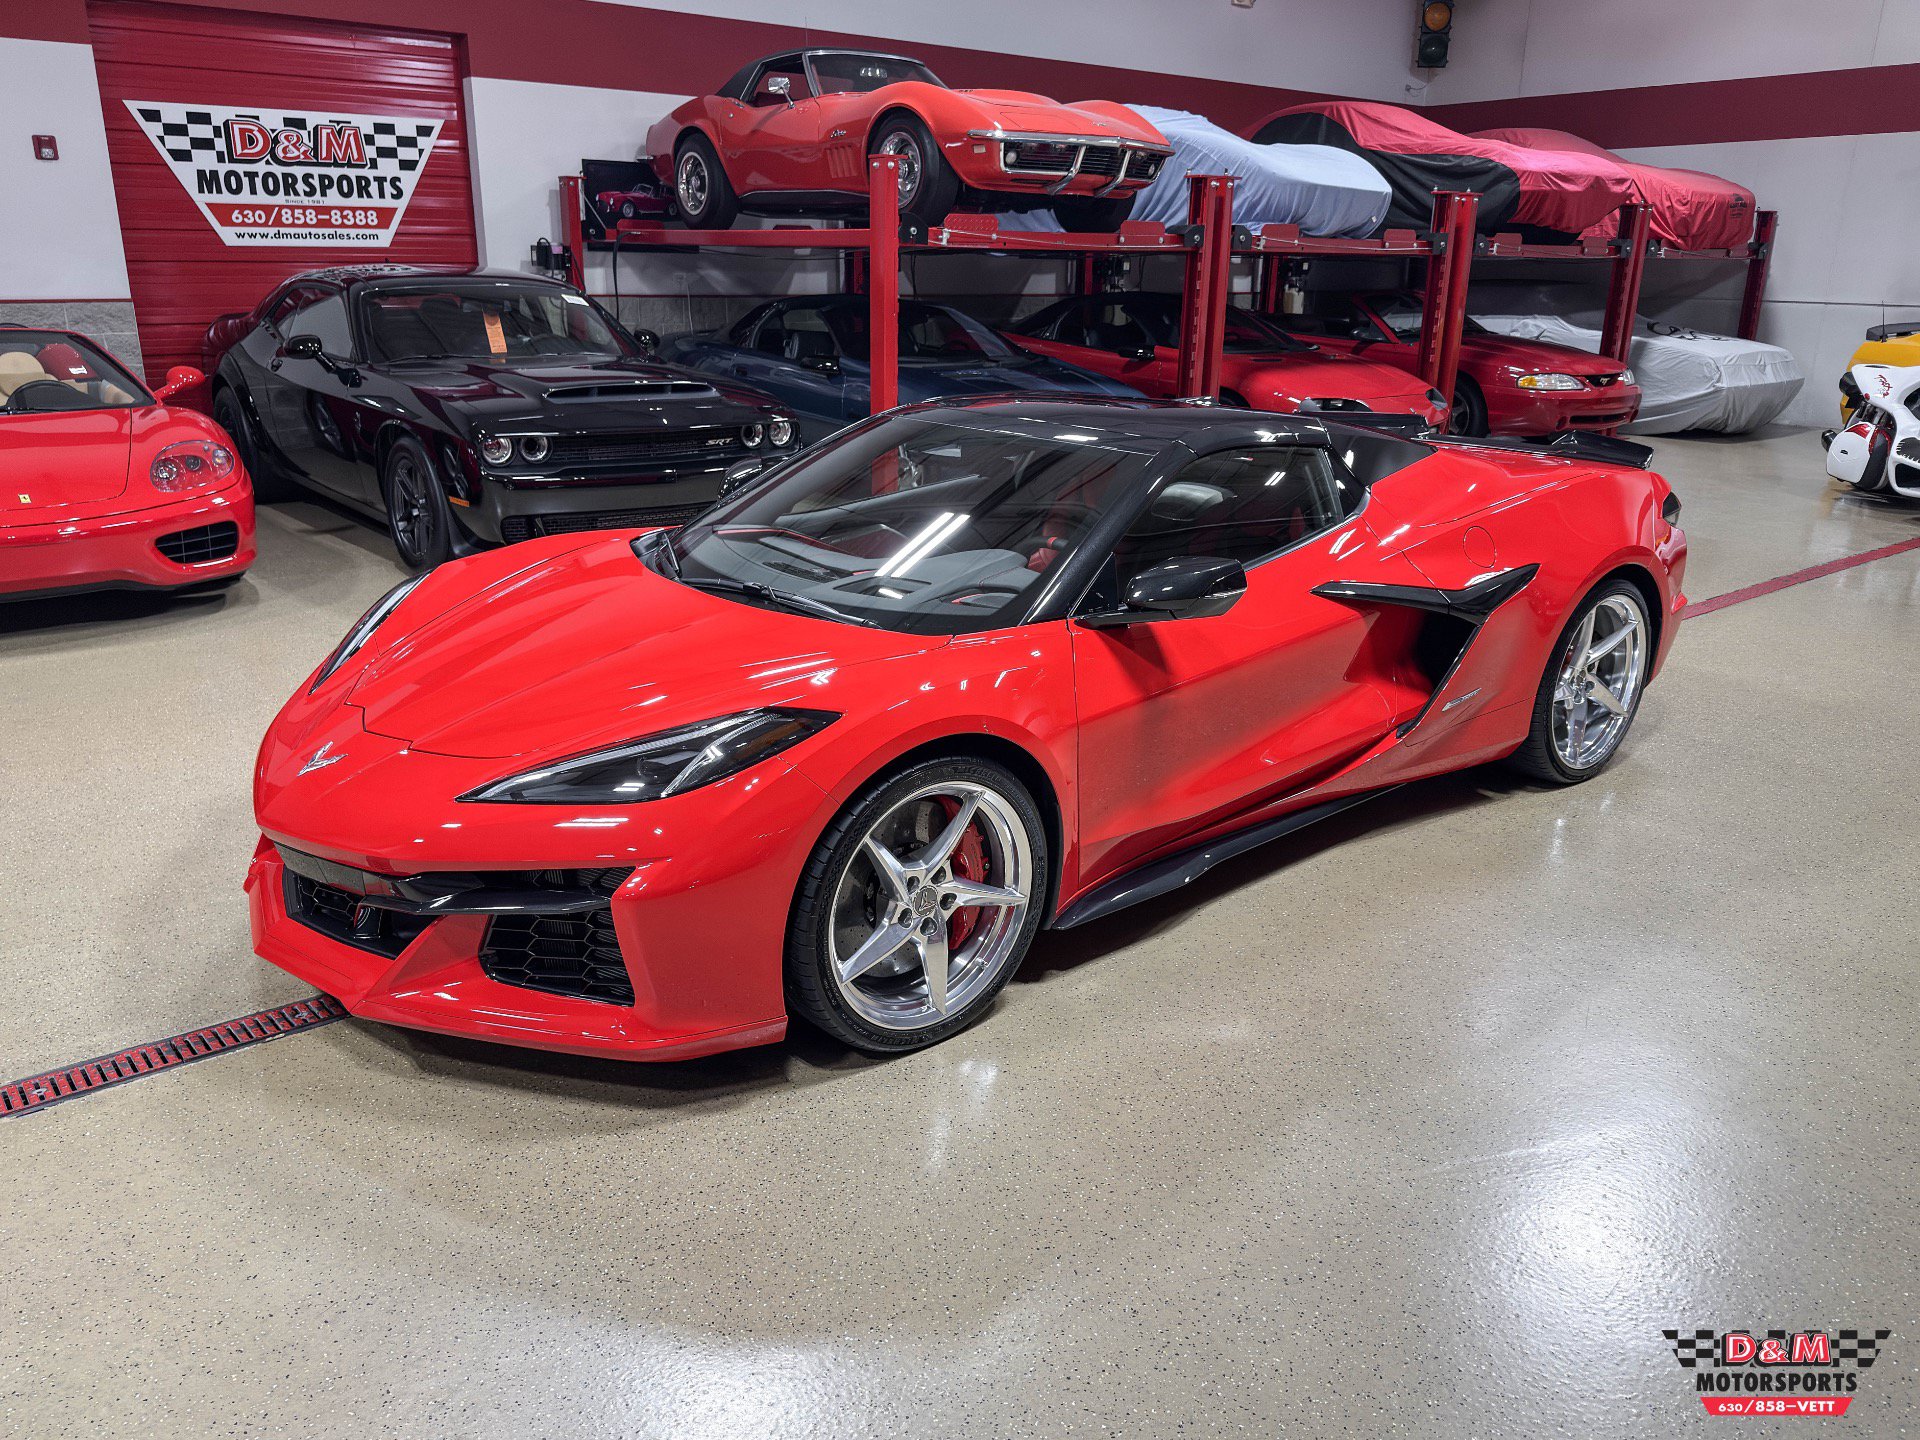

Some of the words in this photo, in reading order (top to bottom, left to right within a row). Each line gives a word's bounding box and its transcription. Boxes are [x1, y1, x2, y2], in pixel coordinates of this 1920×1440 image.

[226, 118, 368, 167] D&M
[196, 169, 404, 200] MOTORSPORTS
[231, 207, 379, 226] 630/858-8388
[234, 229, 379, 242] www.dmautosales.com
[705, 437, 734, 446] SRT
